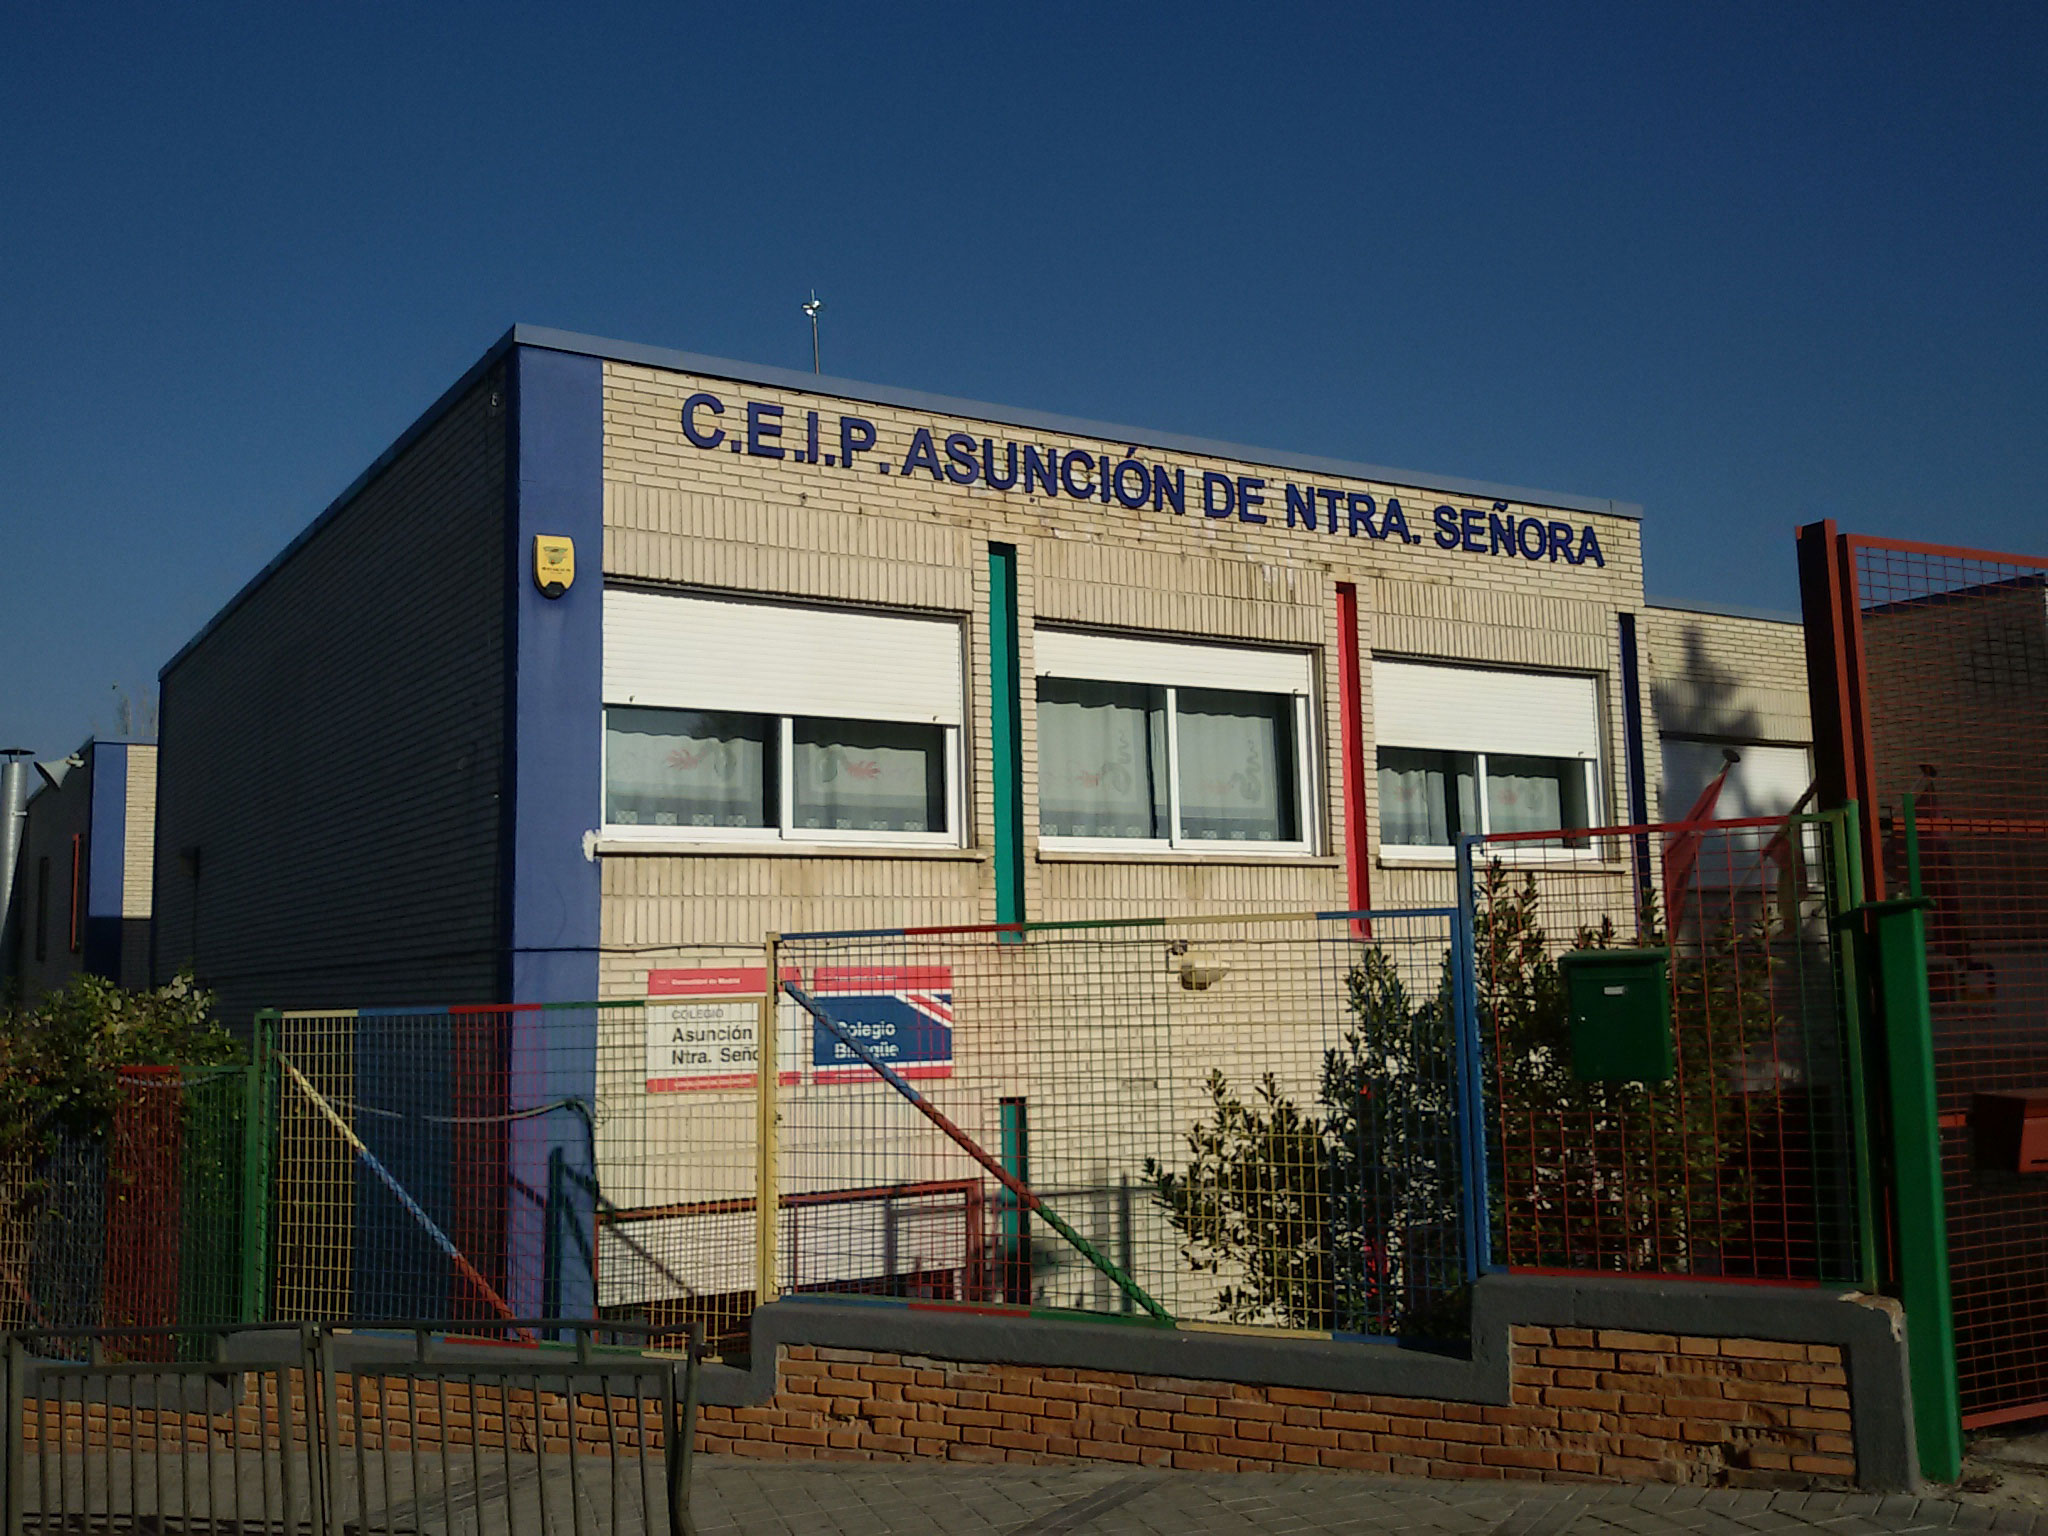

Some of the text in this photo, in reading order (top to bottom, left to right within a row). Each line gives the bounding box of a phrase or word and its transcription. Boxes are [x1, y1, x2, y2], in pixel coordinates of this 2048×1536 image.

[901, 428, 1185, 515] ASUNCIÓN
[1203, 470, 1268, 524] DE
[1285, 483, 1421, 545] NTRA.
[1433, 501, 1606, 568] SEÑORA
[672, 1008, 724, 1020] COLEGIO
[672, 1025, 752, 1043] Asunción
[671, 1049, 712, 1065] Ntra.
